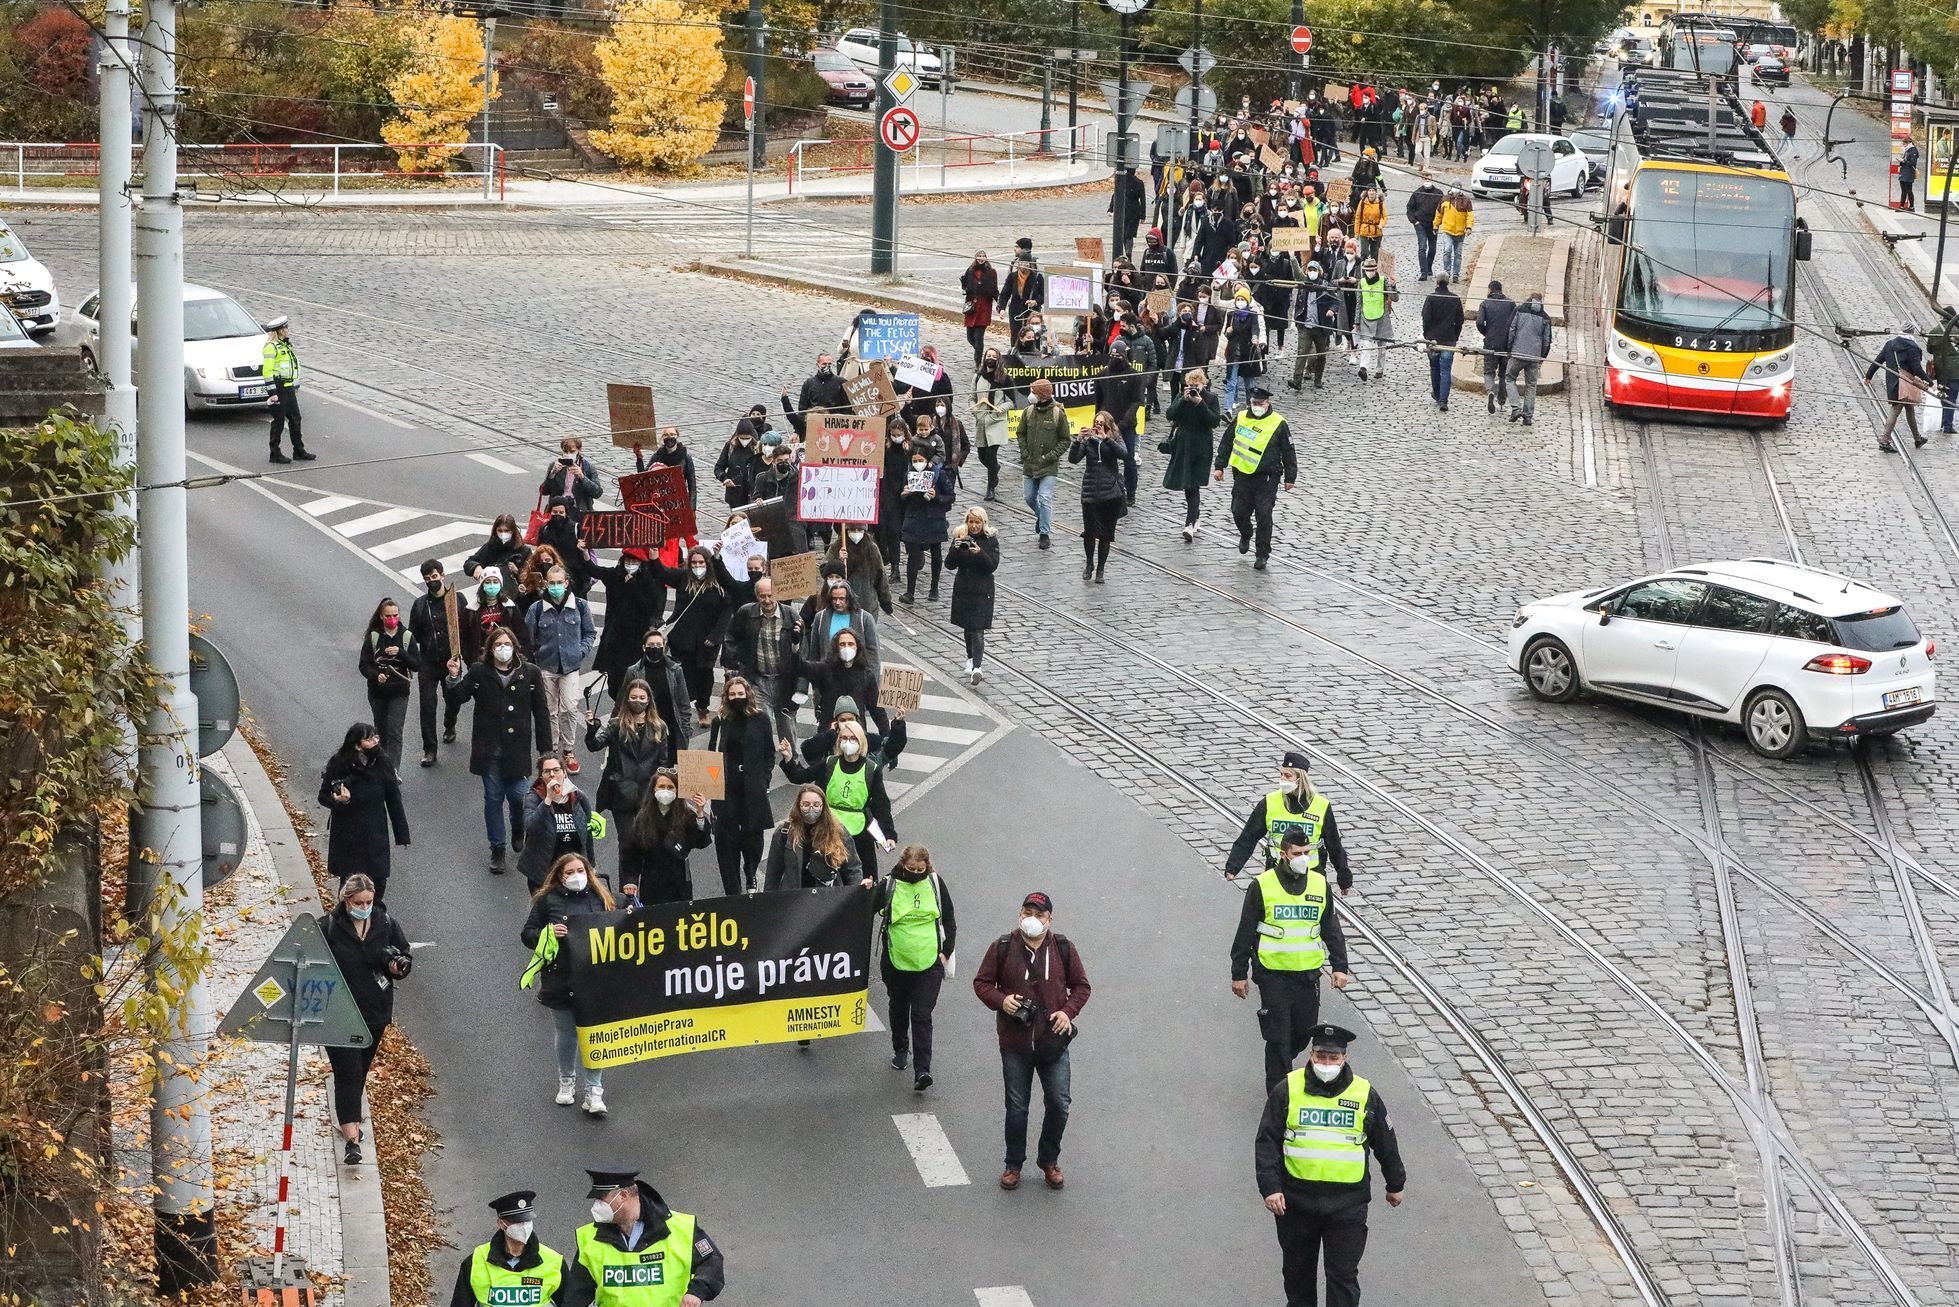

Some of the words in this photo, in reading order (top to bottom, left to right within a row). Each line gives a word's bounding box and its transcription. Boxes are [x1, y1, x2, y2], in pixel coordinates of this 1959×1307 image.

[862, 317, 877, 326] WILL
[878, 317, 892, 326] YOU
[864, 328, 882, 338] THE
[887, 327, 915, 338] FETUS
[863, 340, 872, 353] IF
[1044, 365, 1079, 380] přístup
[1082, 365, 1089, 377] k
[1051, 379, 1096, 398] IDSKÉ
[824, 417, 850, 429] HANDS
[852, 419, 866, 430] OFF
[1275, 906, 1318, 919] POLICIE
[588, 921, 665, 966] Moje
[676, 912, 749, 952] tělo,
[664, 955, 745, 999] moje
[758, 947, 861, 995] práva.
[787, 1004, 841, 1023] AMNESTY
[588, 1016, 694, 1046] #MojeTeloMojePrava
[787, 1019, 841, 1033] INTERNATIONAL
[589, 1029, 727, 1063] @AmnestyInternationalCR
[1300, 1110, 1354, 1126] POLICIE
[605, 1267, 661, 1284] POLICIE
[488, 1288, 541, 1304] POLICIE
